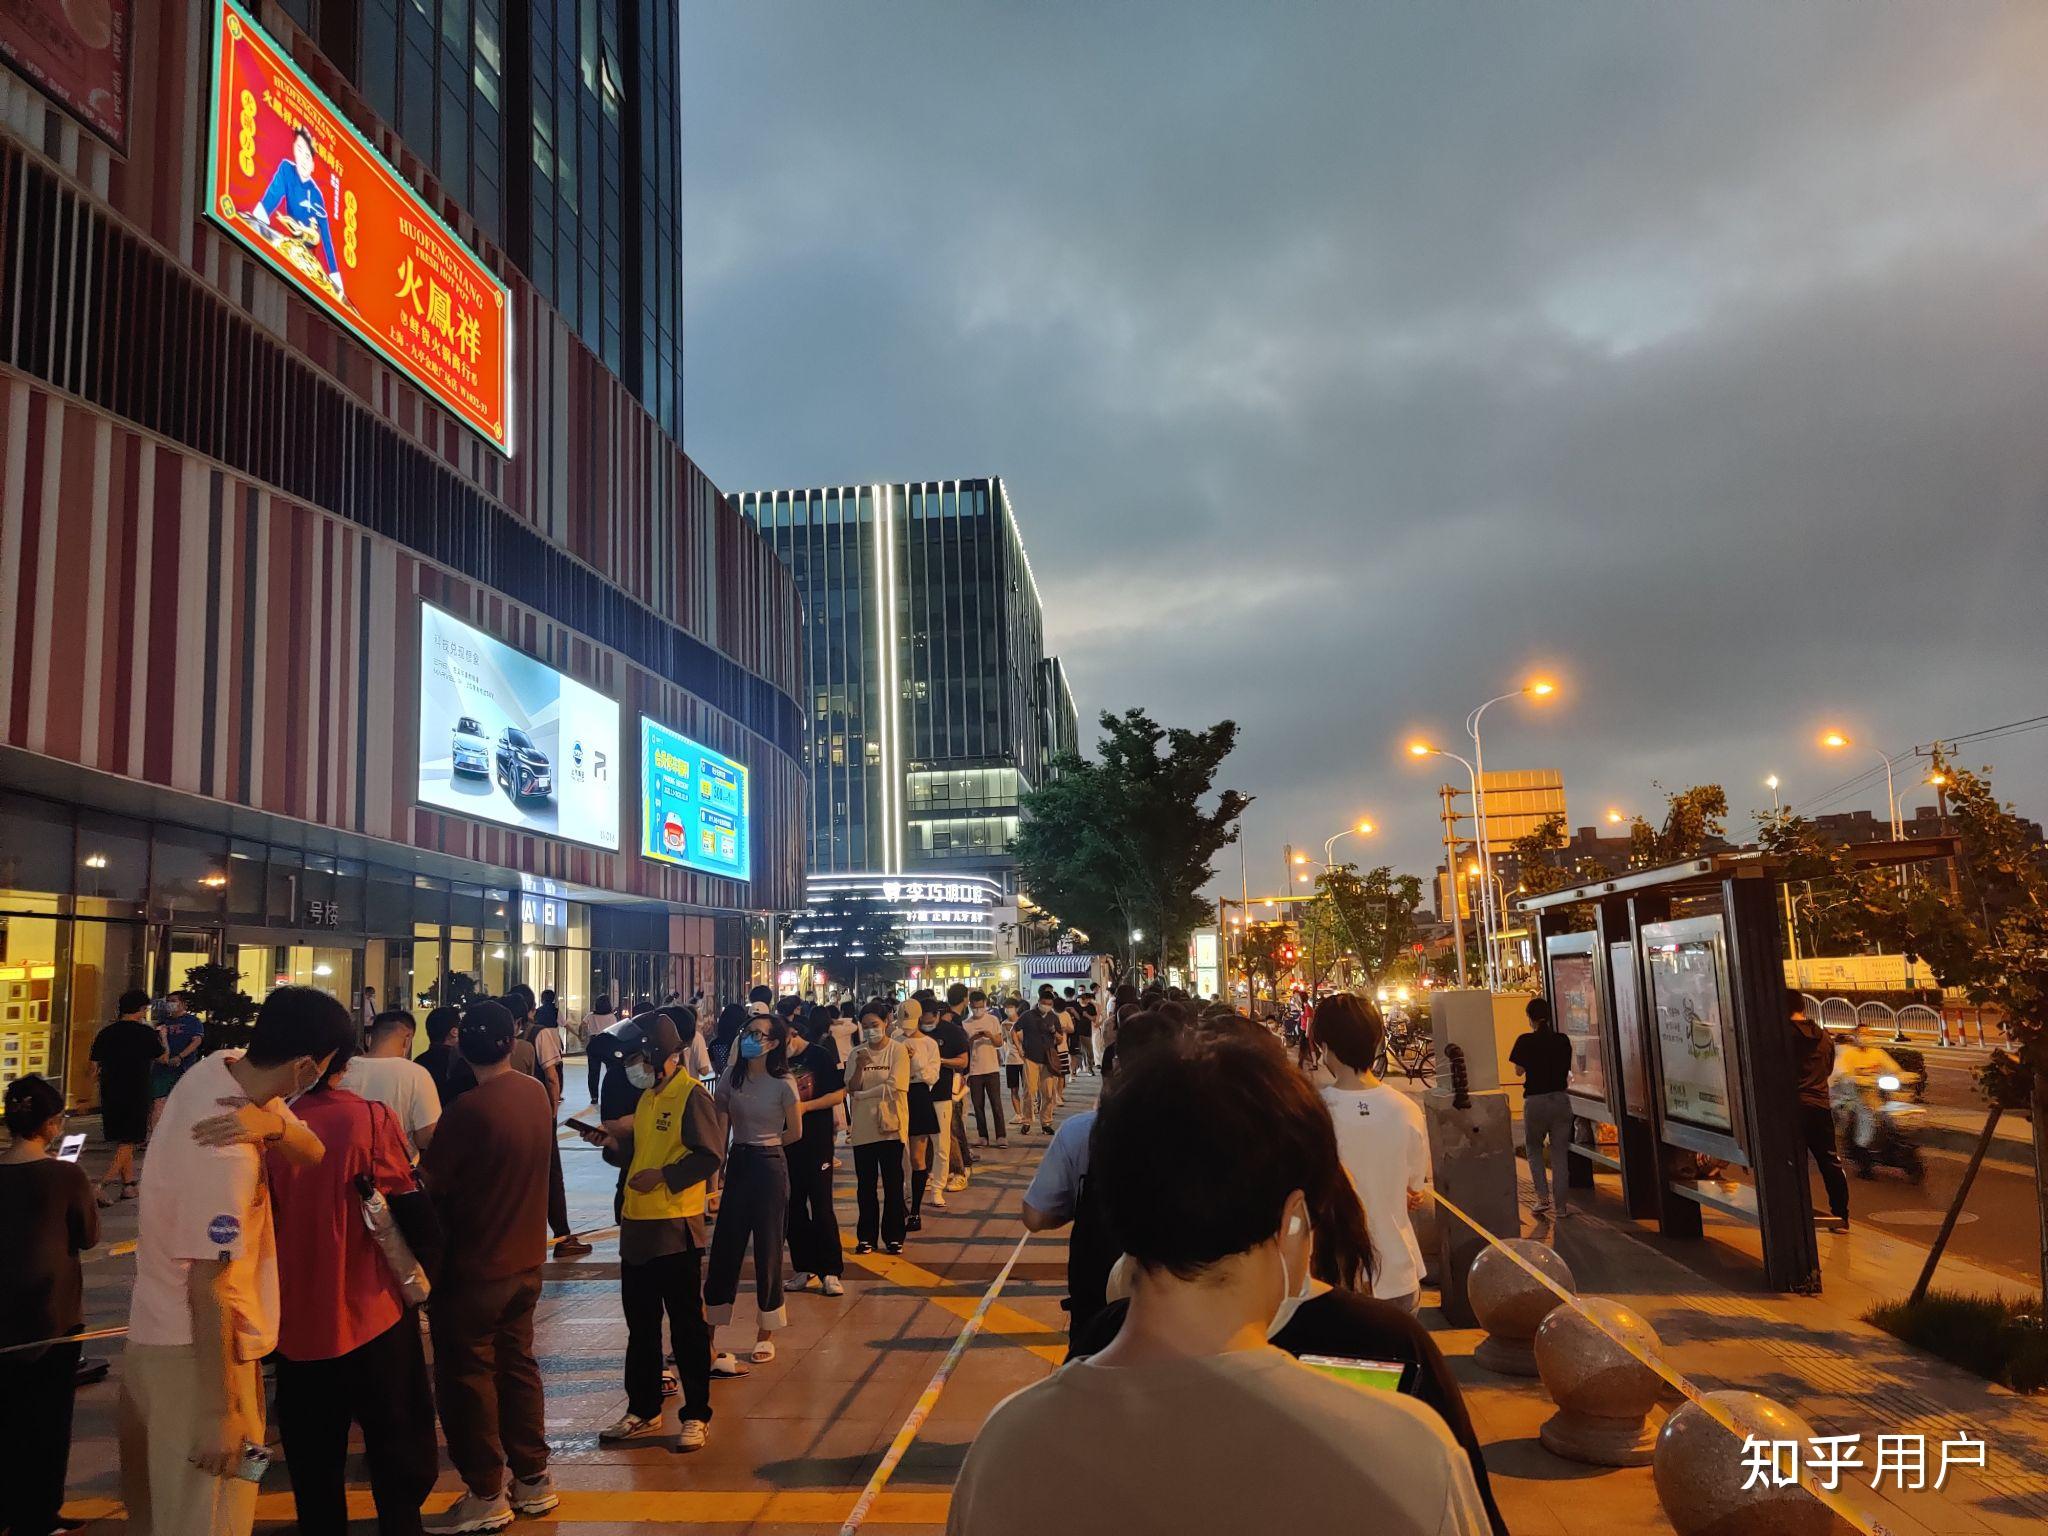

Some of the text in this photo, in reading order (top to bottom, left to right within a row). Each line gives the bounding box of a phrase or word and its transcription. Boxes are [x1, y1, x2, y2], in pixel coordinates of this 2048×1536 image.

[394, 254, 482, 364] 火鳳祥
[399, 216, 484, 310] HUOFENGXIANG
[416, 245, 469, 304] FRESH HOT POT
